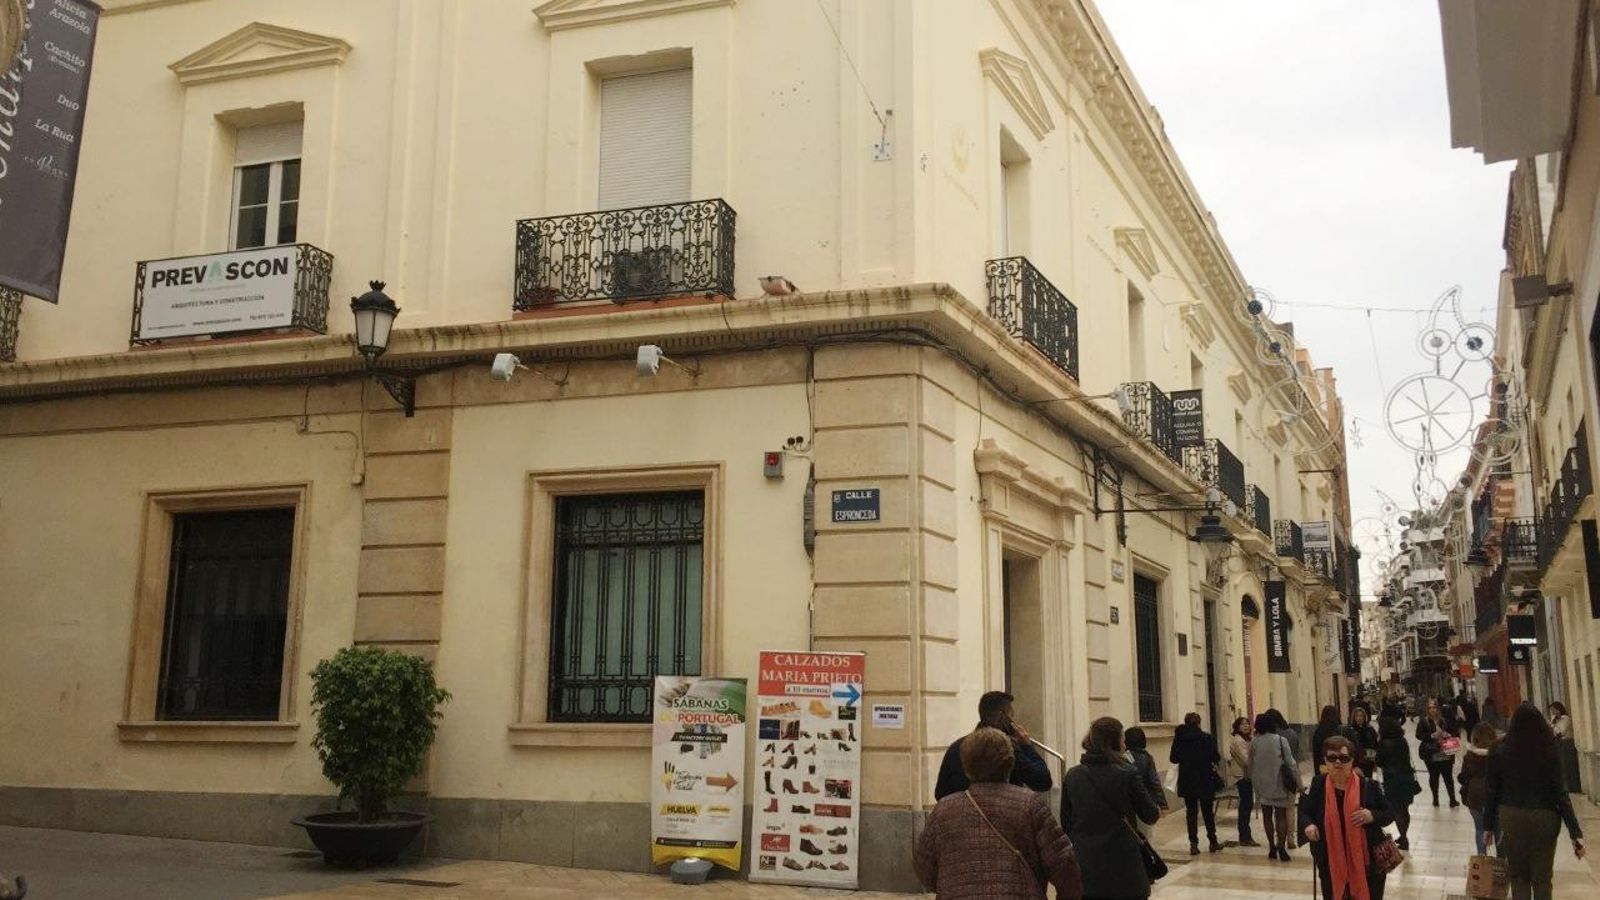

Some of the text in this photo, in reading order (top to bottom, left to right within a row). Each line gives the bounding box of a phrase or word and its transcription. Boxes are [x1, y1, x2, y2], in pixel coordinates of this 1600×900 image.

[57, 93, 80, 111] Duo
[845, 490, 873, 500] CALLE
[835, 509, 877, 521] ESPRONCEDA
[1271, 597, 1280, 620] LOLA
[1272, 628, 1283, 657] BIMBA
[773, 653, 852, 668] CALZADOS
[812, 671, 863, 685] PRIETO
[678, 712, 740, 725] PORTUGAL
[666, 805, 698, 816] HUELVA
